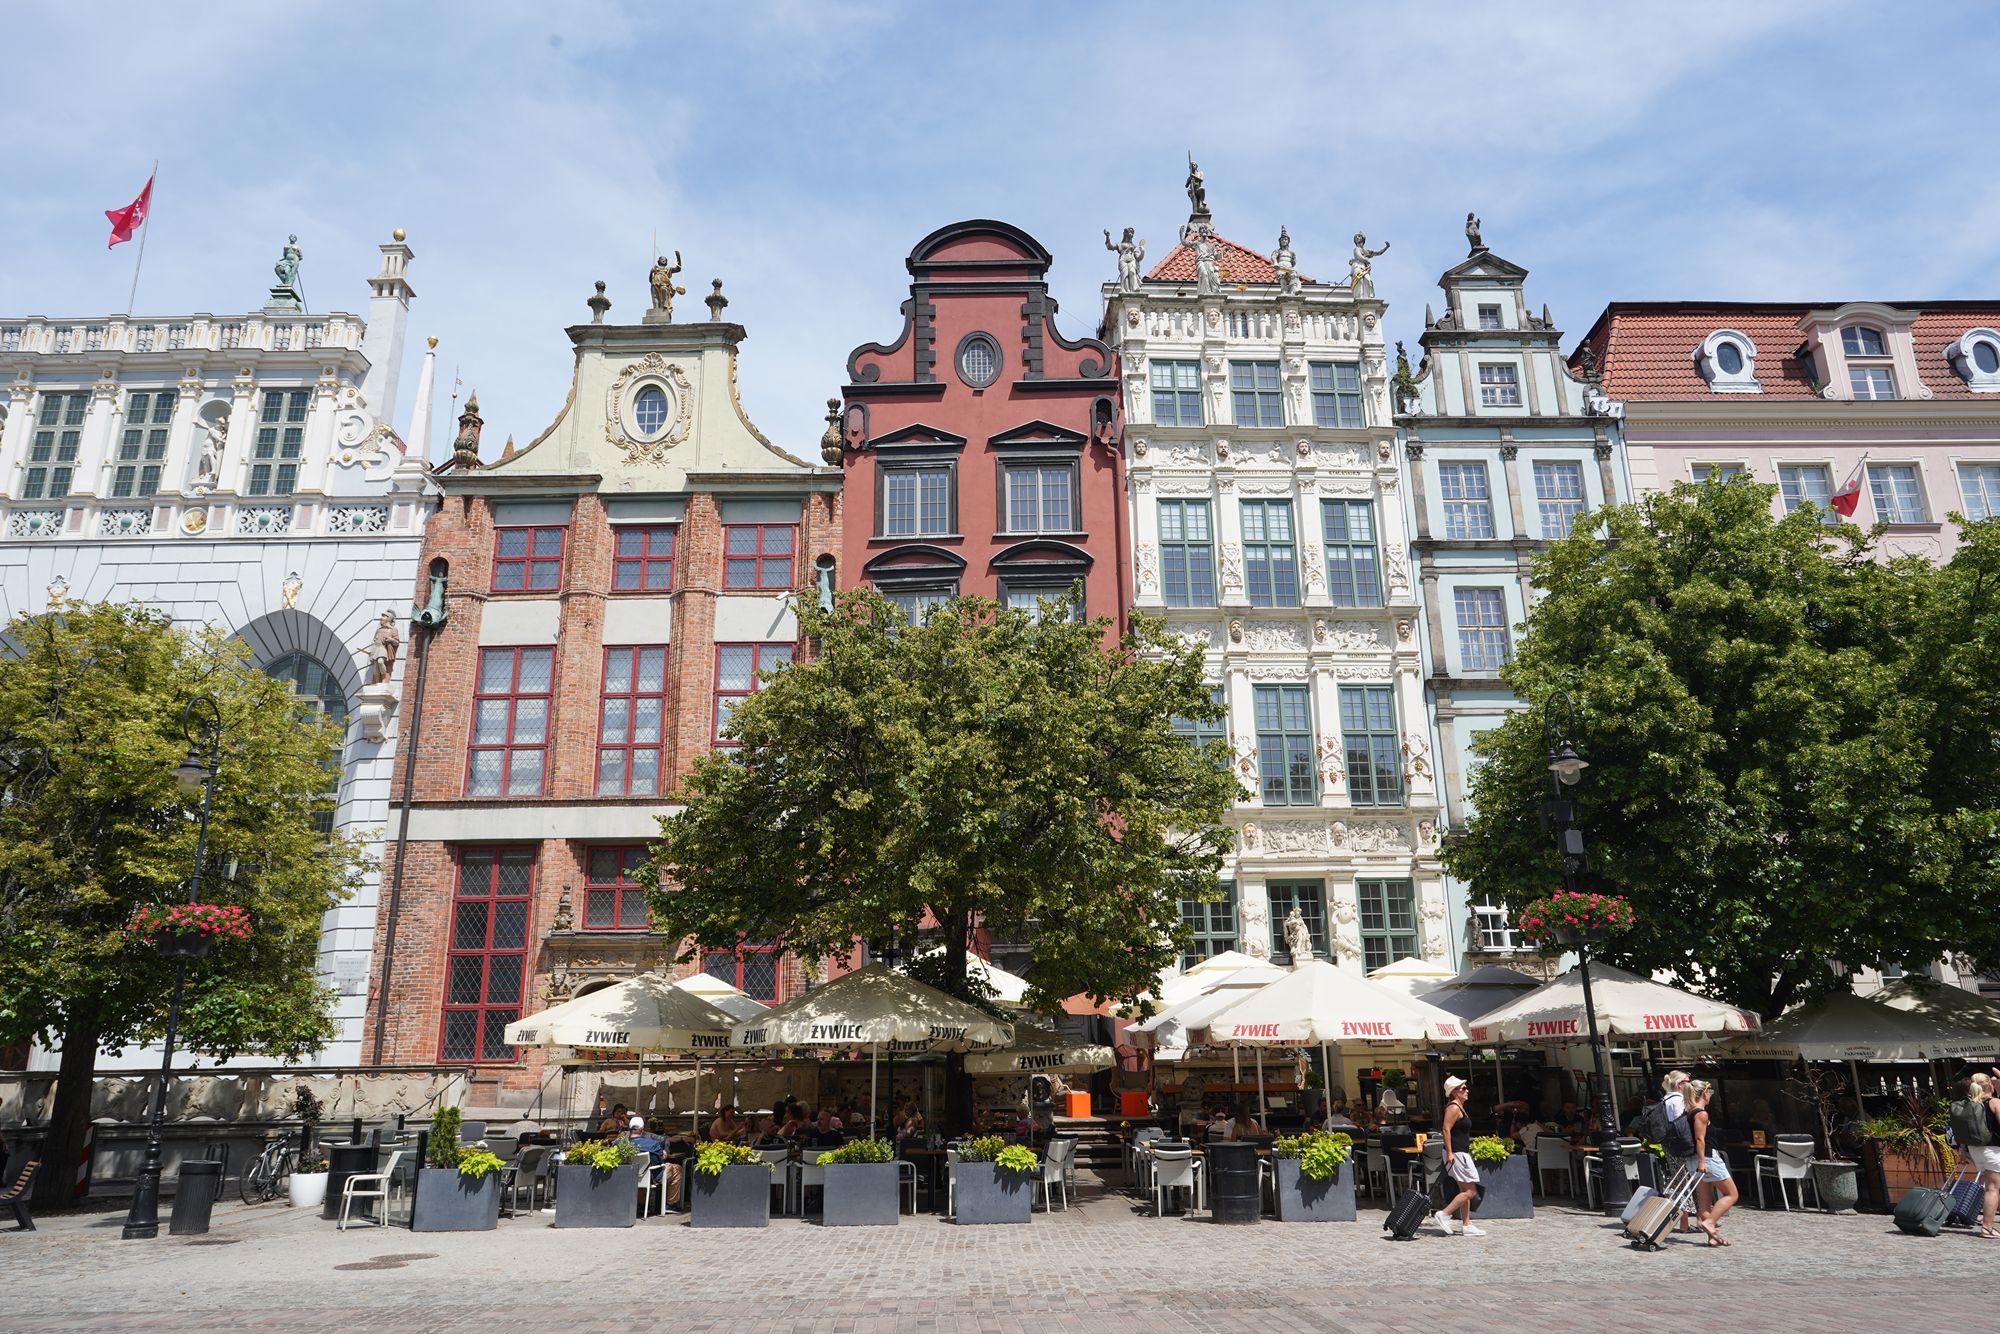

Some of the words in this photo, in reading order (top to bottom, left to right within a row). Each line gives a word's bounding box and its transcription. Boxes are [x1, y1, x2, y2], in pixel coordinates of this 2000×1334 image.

[1341, 1020, 1393, 1036] ŻYWIEC
[1528, 1019, 1577, 1036] ŻYWIEC
[1643, 1014, 1697, 1030] ŻYWIEC
[517, 1030, 538, 1042] ŻYWIEC
[586, 1031, 630, 1044] ŻYWIEC
[743, 1028, 768, 1045] ŻYWIEC
[811, 1025, 862, 1039] ŻYWIEC
[928, 1024, 967, 1039] ŻYWIEC
[1232, 1023, 1279, 1037] ŻYWIEC
[1435, 1023, 1459, 1038] ŻYWIEC
[1471, 1026, 1487, 1041] ŻYWIEC
[691, 1033, 730, 1048] ŻYWIEC
[1020, 1053, 1065, 1069] ŻYWIEC
